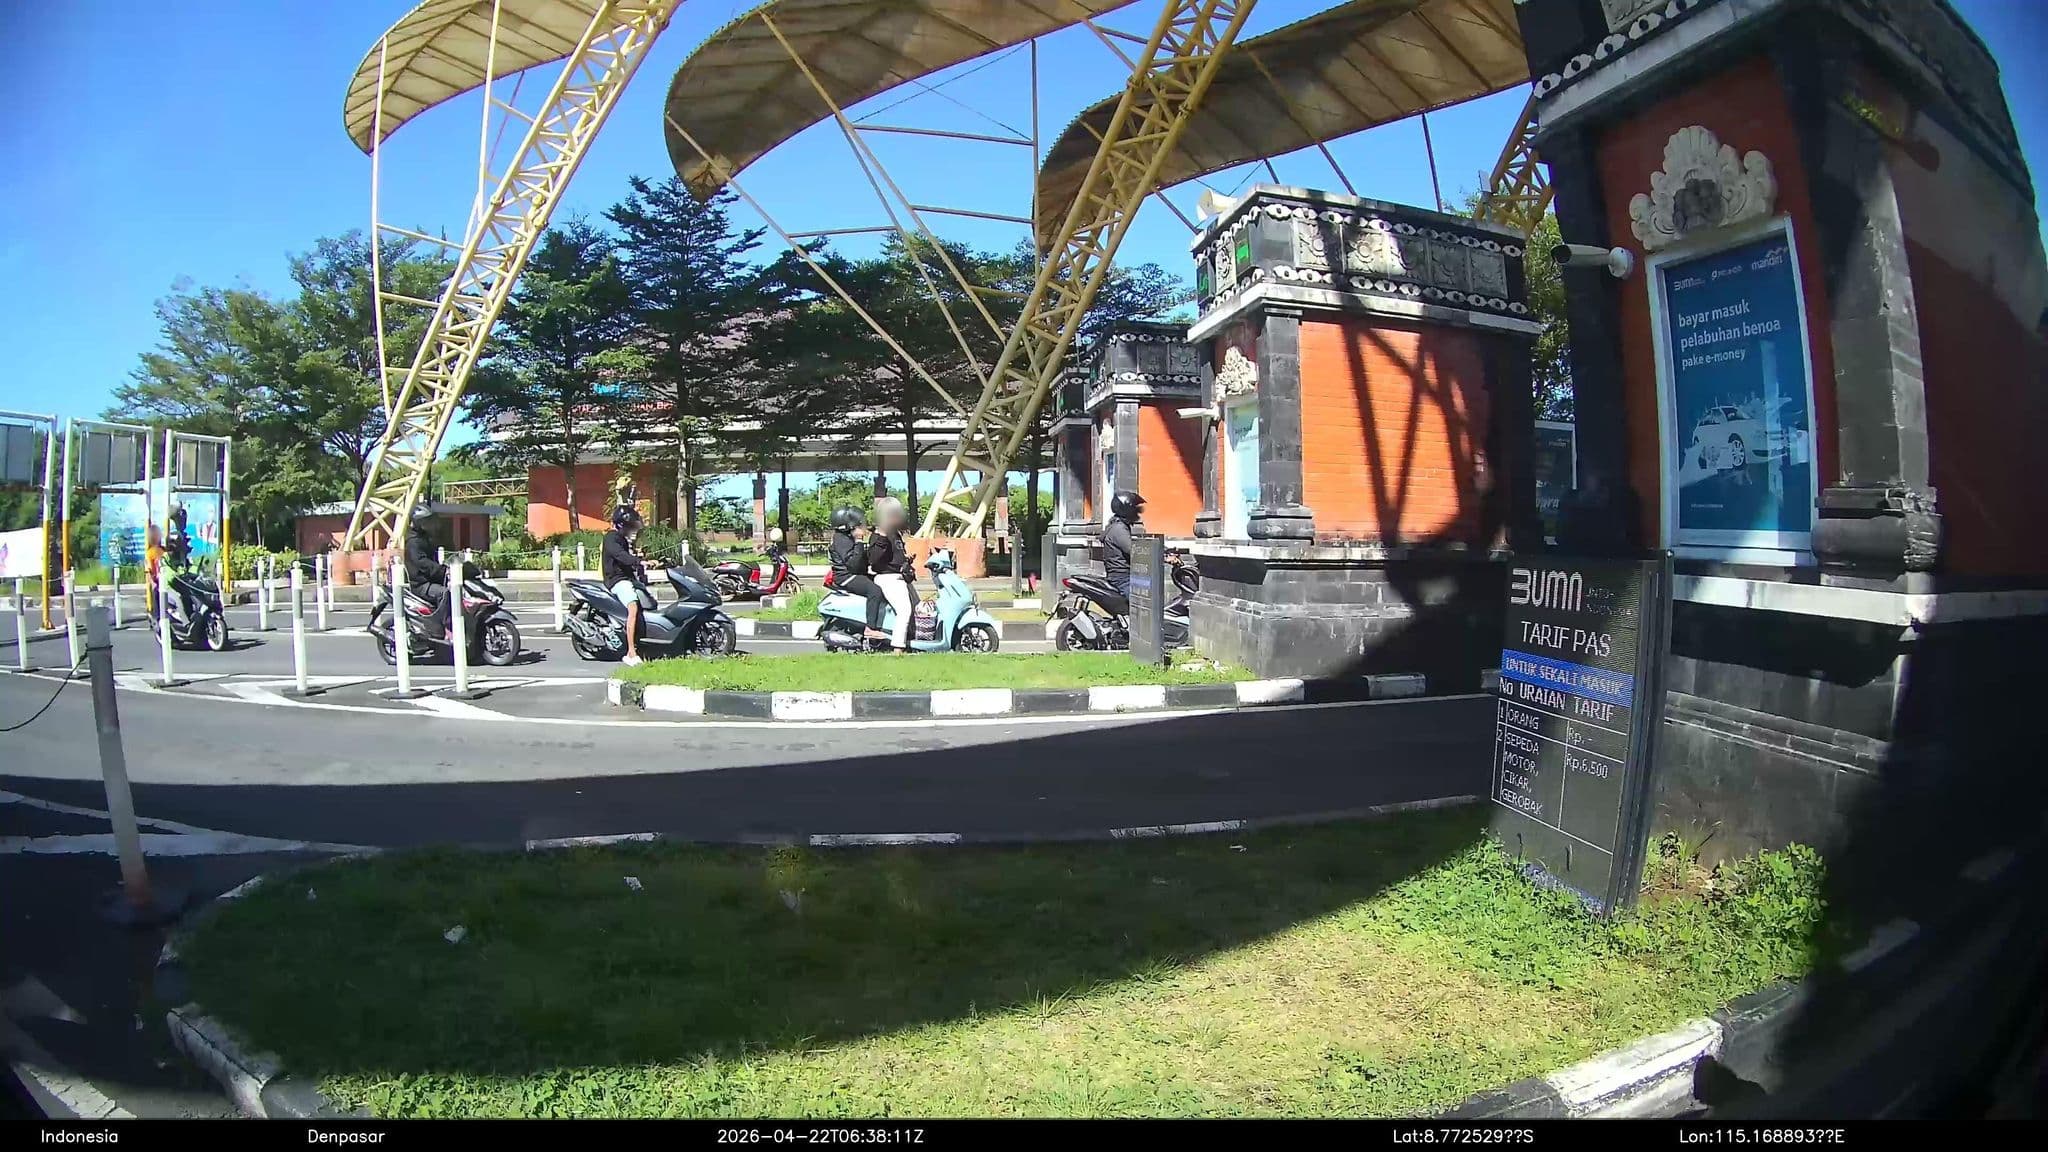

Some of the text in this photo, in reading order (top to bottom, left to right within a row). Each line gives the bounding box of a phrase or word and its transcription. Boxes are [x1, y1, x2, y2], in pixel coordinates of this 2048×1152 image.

[1751, 255, 1784, 271] mandiri
[1678, 299, 1751, 328] bayar masuk
[1680, 319, 1781, 352] pelabuhan benoa
[1682, 349, 1747, 371] pake e-money
[1521, 620, 1612, 657] TARIF PAS
[1505, 657, 1624, 697] UNTUK SEKALI MASUK
[1500, 677, 1616, 722] No URAIAN TARIF
[1500, 706, 1505, 719] 1
[1507, 708, 1540, 730] ORANG
[1496, 729, 1609, 779] 2 SEPEDA Rp.6.500
[1504, 750, 1539, 777] MOTOR,
[1503, 769, 1533, 793] CIKAR,
[1501, 788, 1544, 815] GEROBAK
